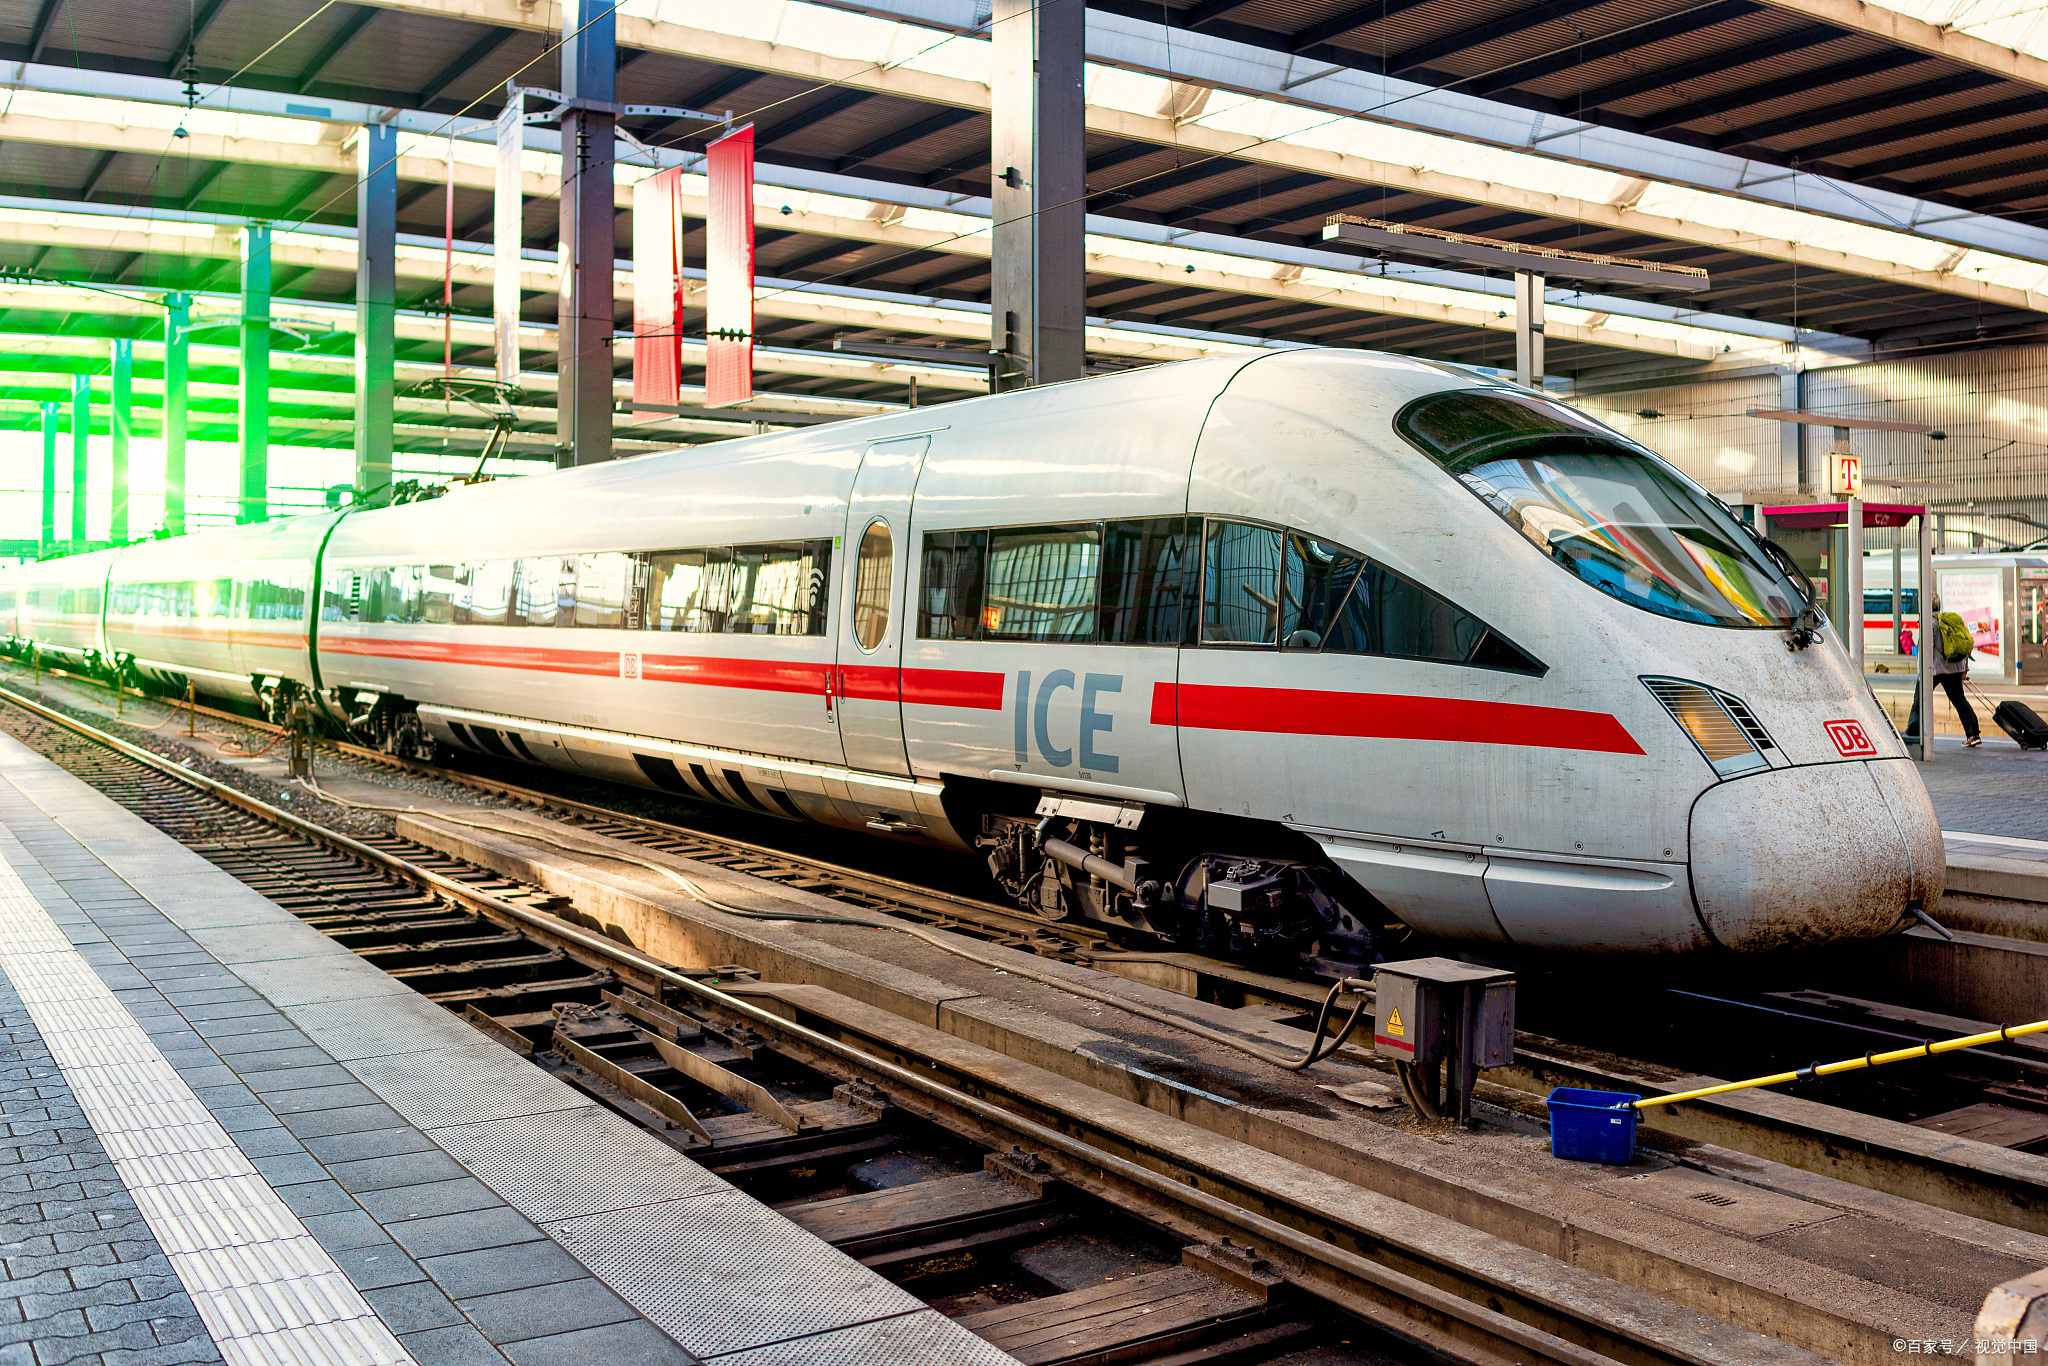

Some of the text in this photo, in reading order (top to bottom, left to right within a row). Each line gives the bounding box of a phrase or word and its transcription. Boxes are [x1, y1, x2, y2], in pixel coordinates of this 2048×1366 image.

[1841, 459, 1858, 490] T
[625, 656, 636, 676] DB
[1014, 669, 1124, 773] ICE
[1829, 723, 1871, 752] DB
